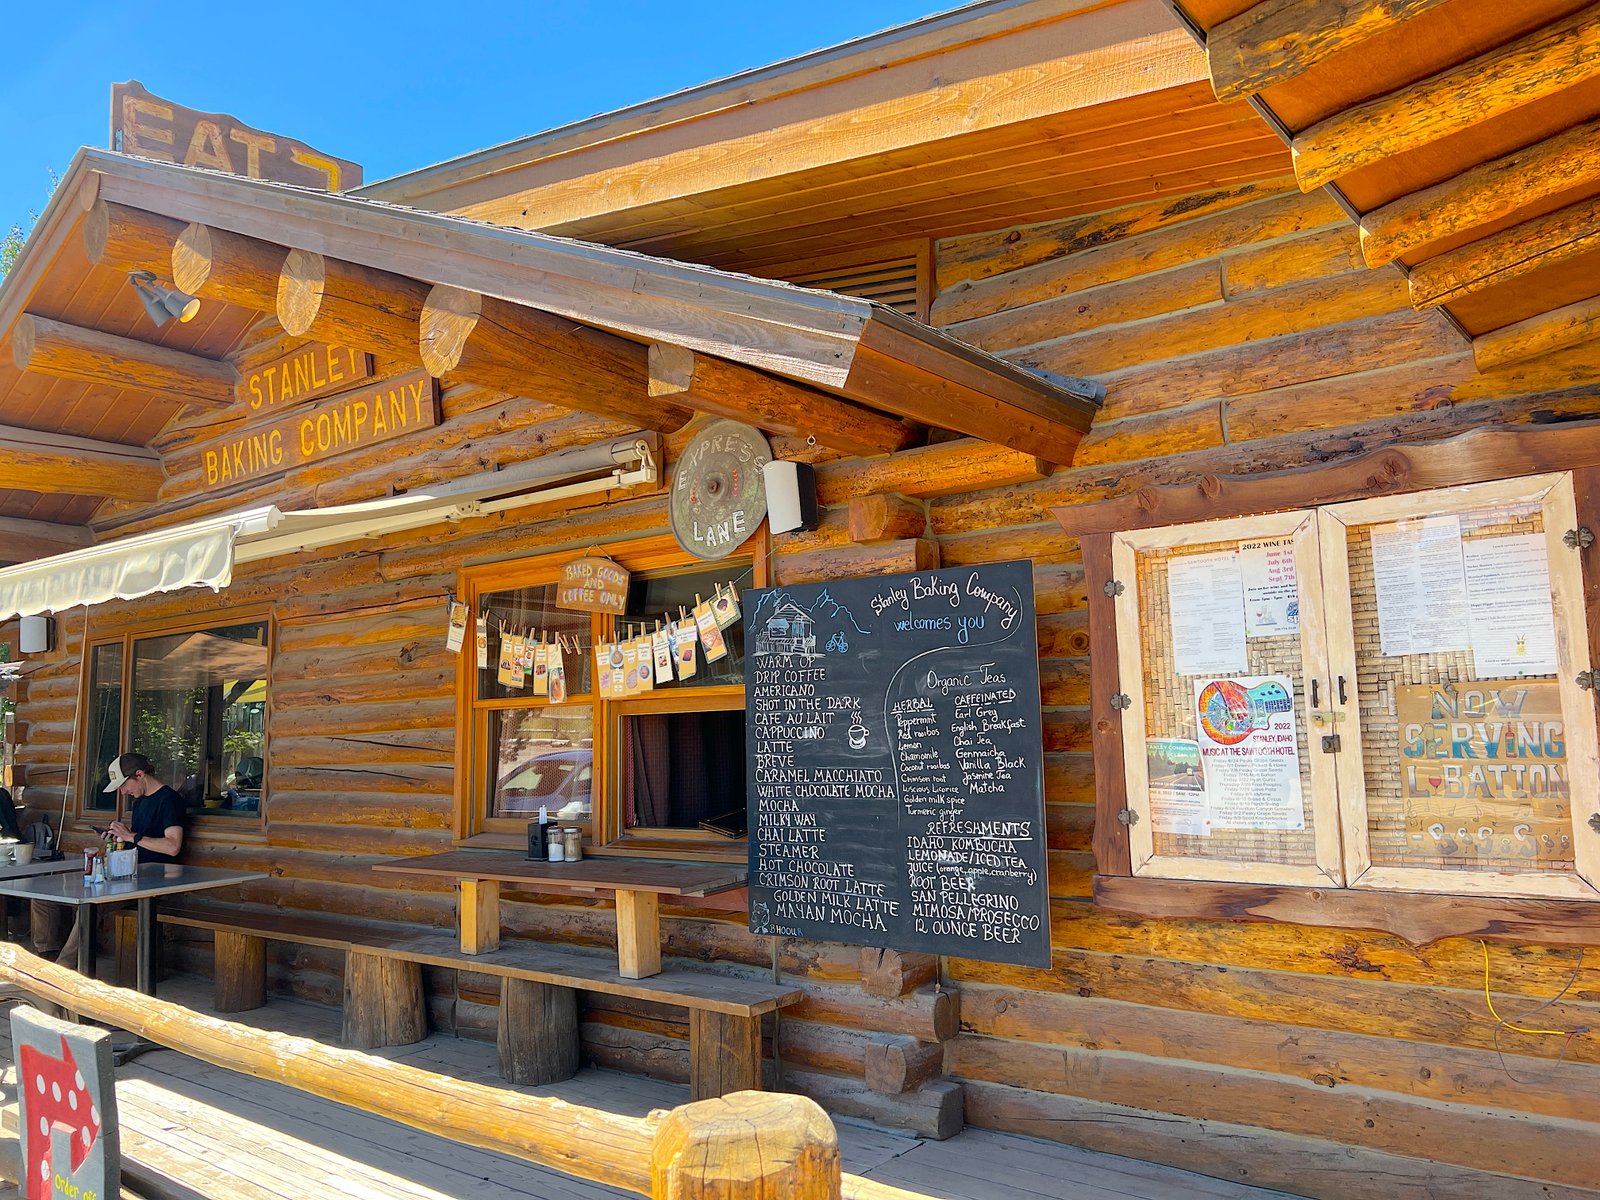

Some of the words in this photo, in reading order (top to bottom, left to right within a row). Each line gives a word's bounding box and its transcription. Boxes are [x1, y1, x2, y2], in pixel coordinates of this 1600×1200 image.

[123, 95, 276, 179] EAT
[249, 343, 359, 410] STANLEY
[205, 429, 283, 486] BAKING
[299, 379, 425, 457] COMPANY
[678, 433, 767, 491] EXPRESS
[693, 510, 746, 547] LANE
[566, 563, 592, 580] BAKED
[597, 566, 625, 586] GOODS
[583, 577, 605, 590] AND
[562, 588, 595, 604] COFFEE
[600, 591, 625, 610] ONLY
[870, 587, 910, 617] Stanley
[909, 575, 960, 608] Baking
[966, 571, 1018, 630] Company
[893, 610, 952, 632] welcomes
[957, 614, 985, 644] you
[756, 656, 794, 669] WARM
[799, 656, 816, 669] UP
[753, 670, 781, 684] DRIP
[784, 668, 826, 683] COFFEE
[927, 670, 973, 696] Organic
[979, 662, 1006, 685] Teas
[753, 683, 815, 697] AMERICANO
[954, 688, 1017, 706] CAFFEINATED
[755, 699, 780, 711] SHOT
[784, 699, 796, 711] IN
[799, 697, 822, 710] THE
[826, 696, 861, 710] DARK
[892, 698, 934, 713] HERBAL
[1431, 690, 1529, 720] NOW
[754, 712, 782, 725] CAFE
[786, 712, 803, 725] AU
[806, 712, 835, 725] LAIT
[895, 713, 937, 731] Peppermint
[955, 708, 971, 719] Earl
[976, 707, 999, 722] Grey
[754, 726, 825, 740] CAPPUCCINO
[897, 729, 911, 740] Red
[914, 726, 940, 738] rooibos
[951, 721, 978, 738] English
[981, 717, 1027, 734] Breakfast
[1274, 722, 1291, 730] 2022
[897, 741, 922, 751] Lemon
[953, 736, 973, 747] Chai
[976, 732, 993, 745] Tea
[1253, 734, 1277, 743] STANLEY,
[1277, 734, 1293, 742] IDAHO
[1403, 720, 1567, 760] SERVING
[756, 741, 794, 754] LATTE
[900, 747, 939, 761] Chamomile
[955, 745, 1006, 759] Genmaicha
[1203, 747, 1220, 756] MUSIC
[1221, 747, 1229, 756] AT
[1230, 747, 1241, 756] THE
[1242, 747, 1275, 756] SAWTOOTH
[1275, 746, 1295, 756] HOTEL
[755, 754, 795, 769] BREVE
[900, 761, 924, 773] Coconut
[958, 758, 992, 771] Vanilla
[994, 757, 1027, 771] Black
[755, 768, 810, 783] CARAMEL
[813, 768, 883, 783] MACCHIATO
[900, 774, 931, 783] Crimson
[932, 773, 947, 783] root
[962, 771, 994, 786] Jasmine
[995, 769, 1012, 780] Tea
[756, 785, 792, 798] WHITE
[795, 784, 851, 798] CHOCOLATE
[854, 785, 896, 799] MOCHA
[902, 785, 931, 794] Luscious
[931, 783, 960, 794] Licorice
[969, 782, 1006, 795] Matcha
[758, 799, 800, 812] MOCHA
[903, 795, 927, 804] Golden
[946, 796, 966, 810] spice
[758, 813, 791, 827] MILKY
[793, 813, 817, 827] WAY
[905, 804, 936, 816] Turmeric
[939, 807, 964, 821] ginger
[757, 828, 785, 842] CHAI
[788, 829, 826, 842] LATTE
[926, 820, 1032, 837] REFRESHMENTS
[758, 843, 820, 859] STEAMER
[907, 836, 944, 849] IDAHO
[951, 838, 1018, 854] KOMBUCHA
[908, 850, 1001, 868] LEMONADE/ICED
[1001, 855, 1028, 869] TEA
[758, 859, 784, 872] HOT
[788, 859, 855, 877] CHOCOLATE
[907, 862, 934, 877] JUICE
[759, 872, 809, 889] CRIMSON
[812, 876, 840, 891] ROOT
[845, 879, 887, 898] LATTE
[909, 875, 937, 890] ROOT
[939, 875, 976, 891] BEER
[773, 889, 817, 904] GOLDEN
[821, 892, 852, 909] MILK
[856, 897, 900, 917] LATTE
[911, 890, 937, 902] SAN
[939, 890, 1019, 911] PELLEGRINO
[775, 902, 826, 921] MAYAN
[829, 908, 888, 932] MOCHA
[912, 903, 1040, 931] MIMOSA/PROSECCO
[915, 918, 929, 934] 12
[932, 920, 979, 938] OUNCE
[981, 923, 1022, 944] BEER
[54, 1173, 80, 1199] Order
